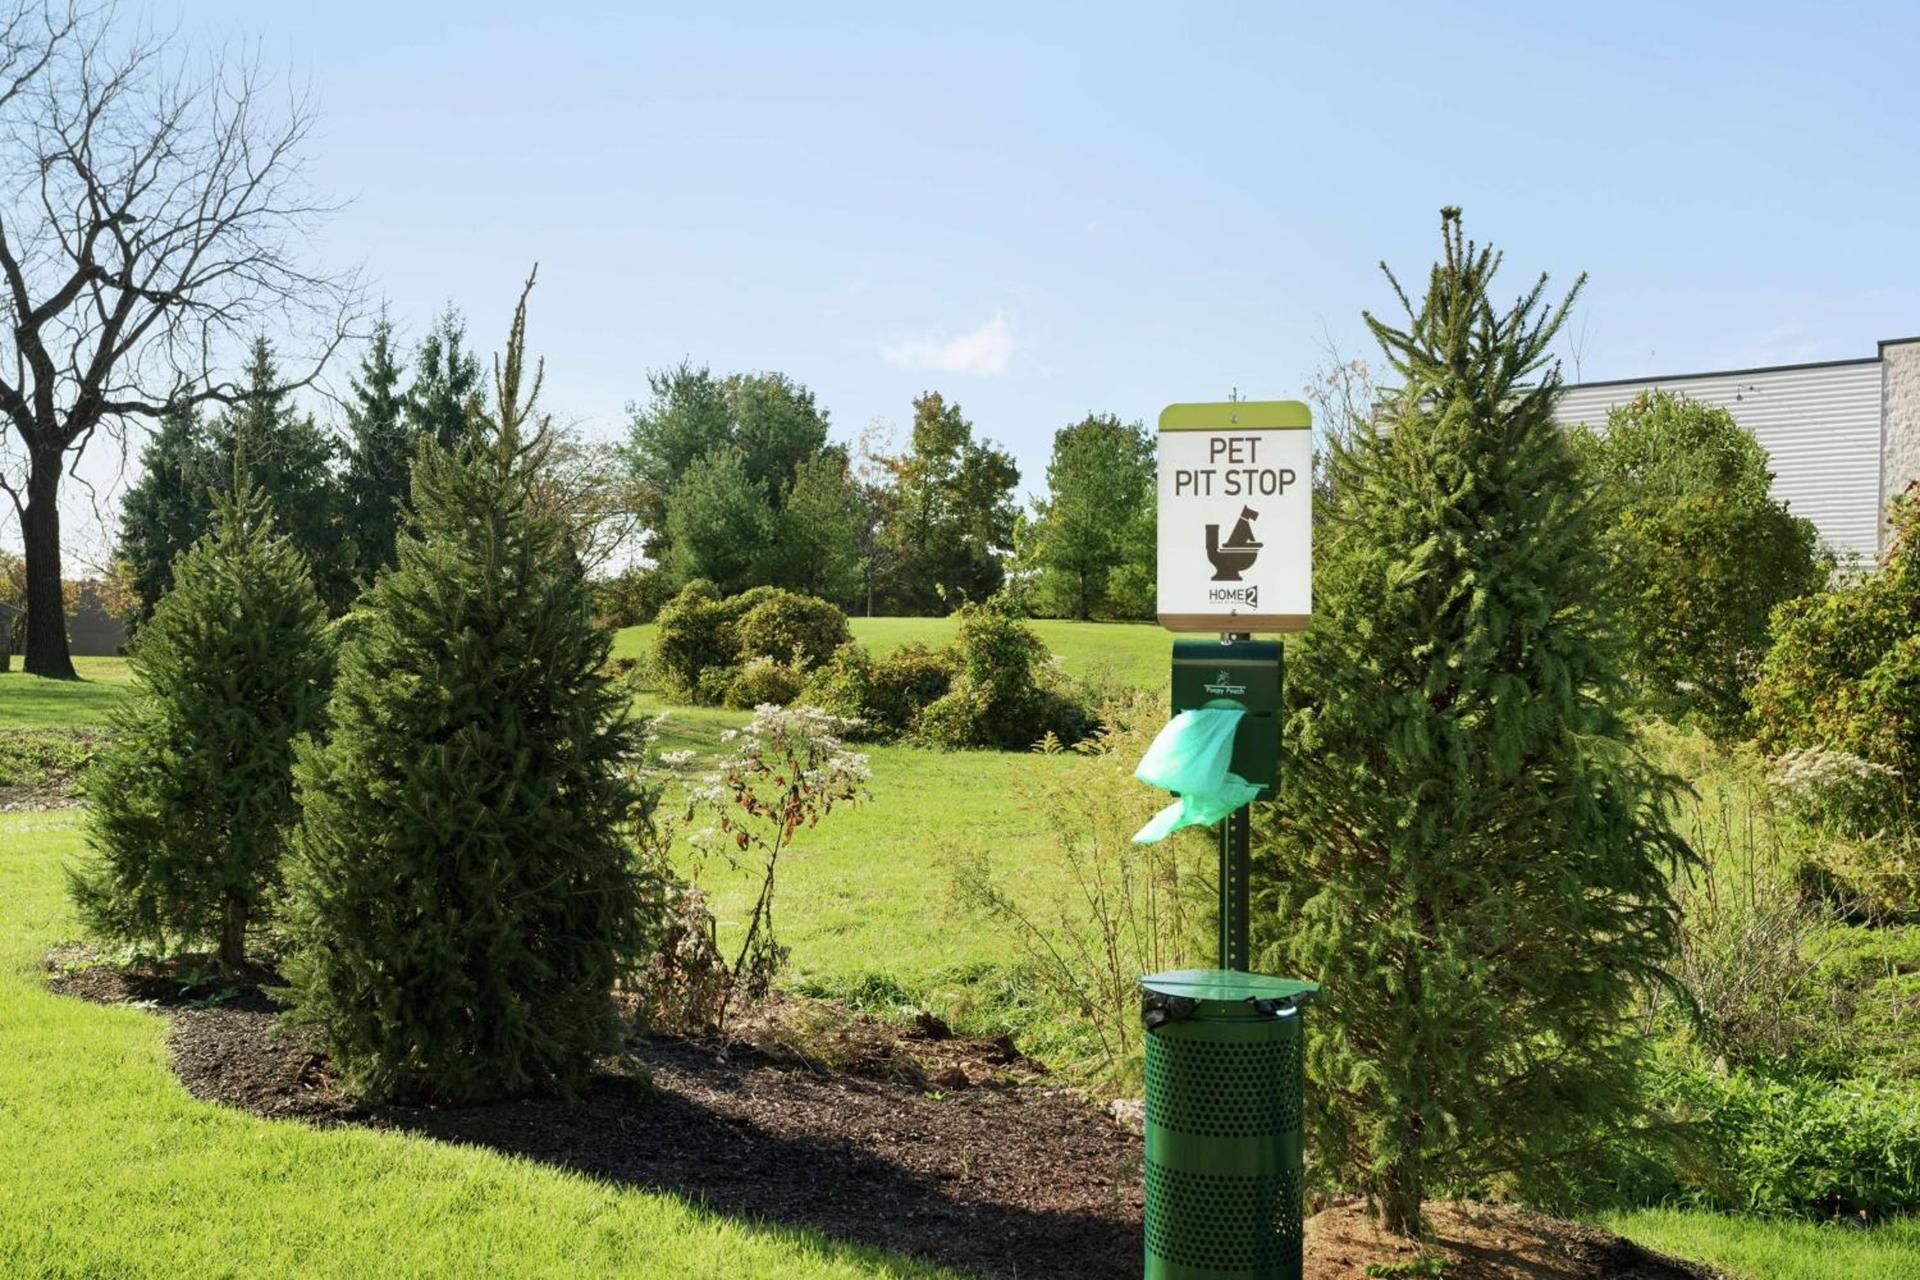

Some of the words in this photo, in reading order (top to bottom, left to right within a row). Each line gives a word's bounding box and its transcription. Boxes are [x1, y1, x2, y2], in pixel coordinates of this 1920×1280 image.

[1210, 437, 1262, 464] PET
[1175, 470, 1217, 497] PIT
[1224, 468, 1296, 497] STOP
